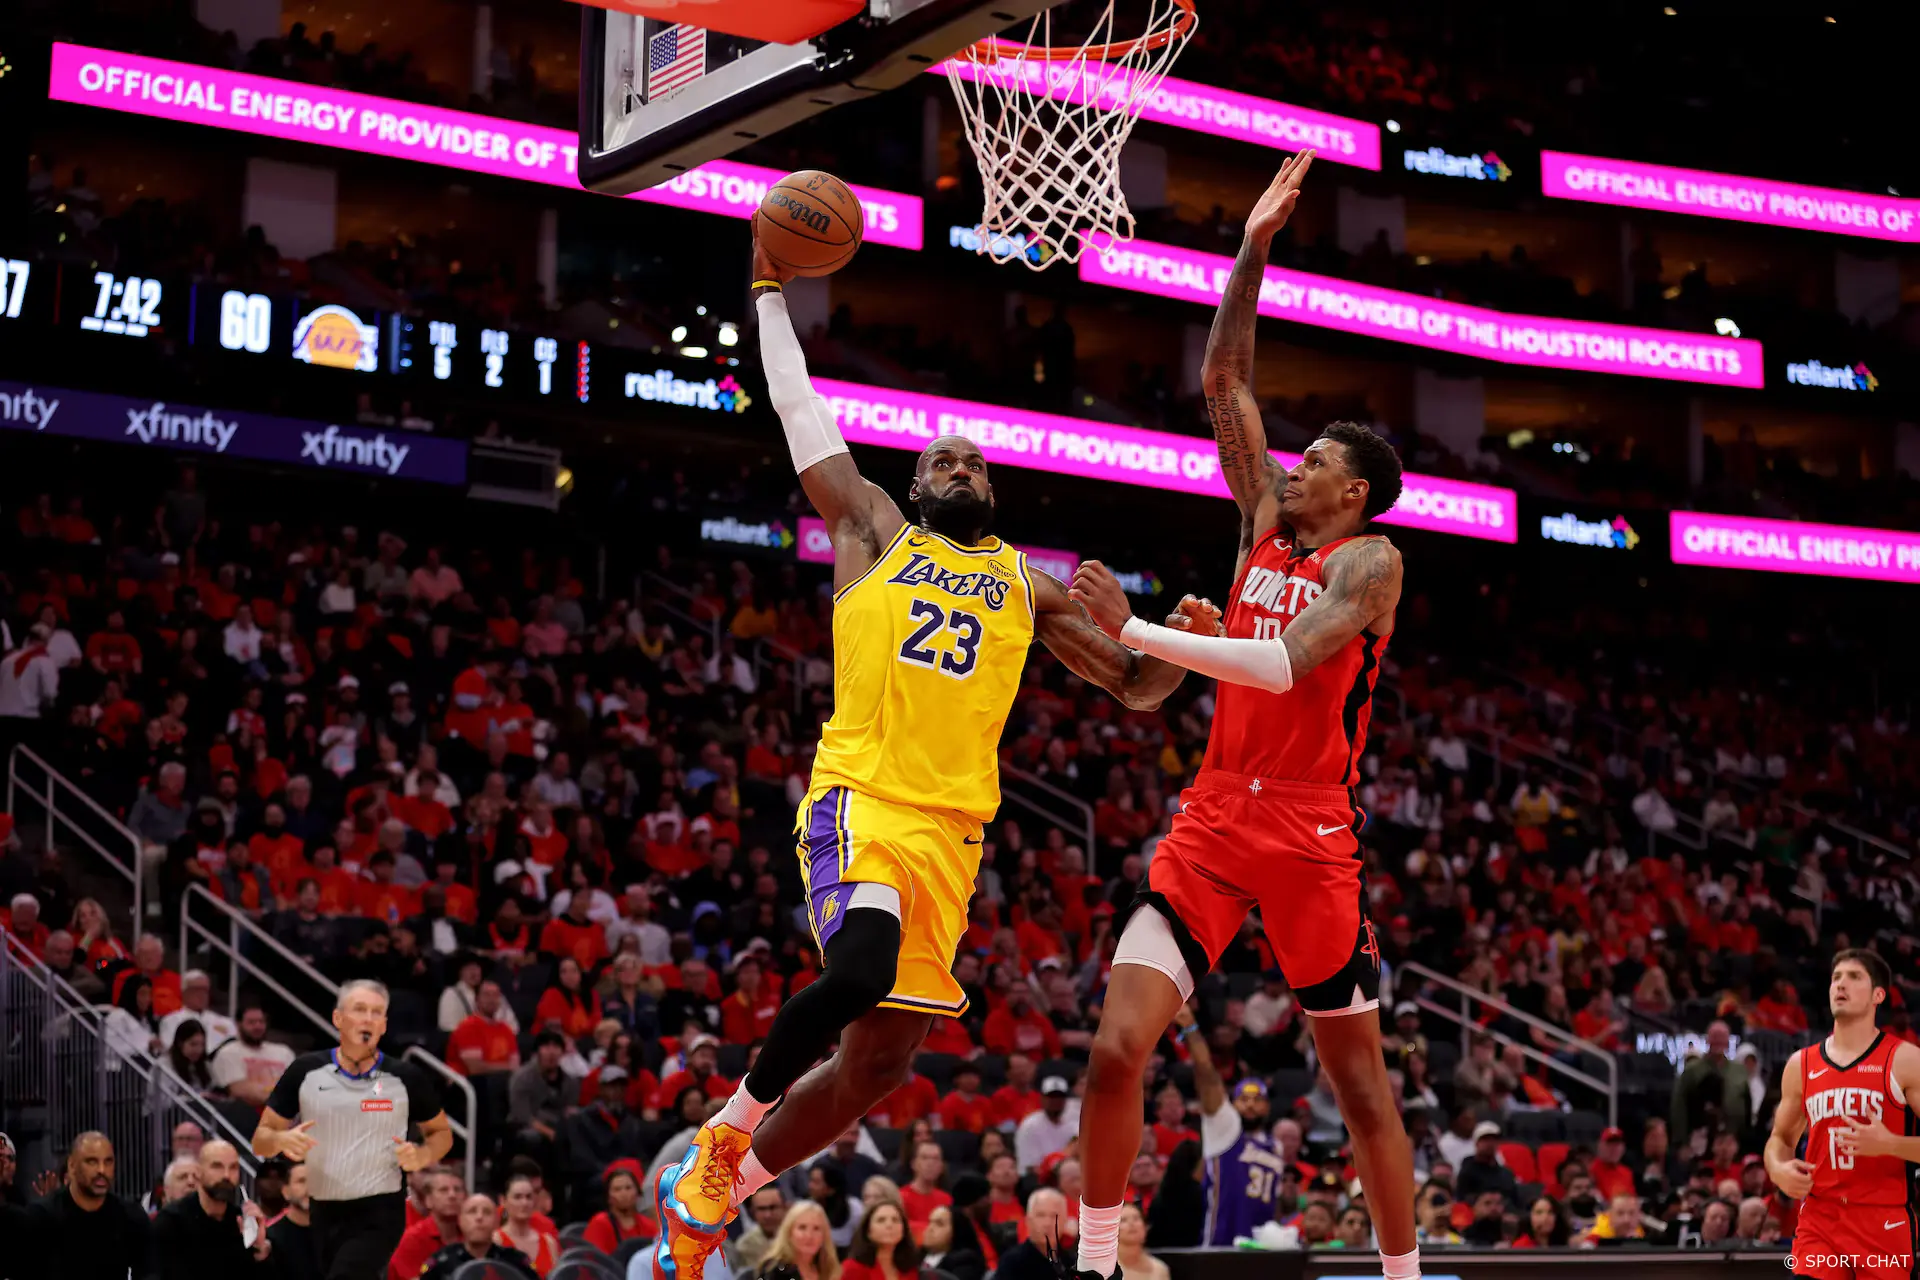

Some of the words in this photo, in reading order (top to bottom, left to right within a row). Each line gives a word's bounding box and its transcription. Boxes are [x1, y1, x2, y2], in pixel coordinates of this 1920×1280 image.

[78, 62, 225, 112] OFFICIAL
[230, 87, 356, 134] ENERGY
[360, 109, 510, 162] PROVIDER
[514, 138, 559, 169] OF
[1134, 87, 1250, 130] HOUSTON
[1251, 110, 1356, 155] ROCKETS
[1404, 147, 1486, 180] reliant
[770, 192, 831, 235] Wilson
[1564, 166, 1673, 201] OFFICIAL
[1674, 180, 1765, 213] ENERGY
[1769, 193, 1880, 229] PROVIDER
[1882, 208, 1915, 232] OF
[94, 271, 162, 326] 7:42
[1101, 248, 1211, 292] OFFICIAL
[1213, 266, 1304, 309] ERGY
[1307, 286, 1419, 333] PROVIDER
[1421, 309, 1453, 337] OF
[1455, 316, 1499, 349] THE
[1501, 324, 1627, 363] HOUSTON
[1628, 337, 1742, 375] ROCKETS
[219, 290, 271, 353] 60
[434, 346, 451, 379] 5
[485, 354, 503, 387] 2
[538, 361, 551, 394] 1
[1787, 359, 1857, 390] reliant
[625, 370, 721, 410] reliant
[1215, 372, 1239, 449] MEDIOCRITY
[125, 402, 239, 453] xfinity
[937, 412, 1048, 455] ENERGY
[1049, 429, 1180, 476] PROVIDER
[1181, 452, 1218, 481] OF
[301, 425, 410, 475] xfinity
[1243, 453, 1260, 490] Breeds
[701, 516, 771, 547] reliant
[1541, 512, 1615, 548] reliant
[1683, 525, 1797, 561] OFFICIAL
[1798, 536, 1892, 569] ENERGY
[884, 552, 1011, 612] LAKERS
[989, 562, 1015, 578] bibigo
[898, 597, 984, 681] 23
[1805, 1087, 1884, 1128] ROCKETS
[1246, 1166, 1275, 1203] 31
